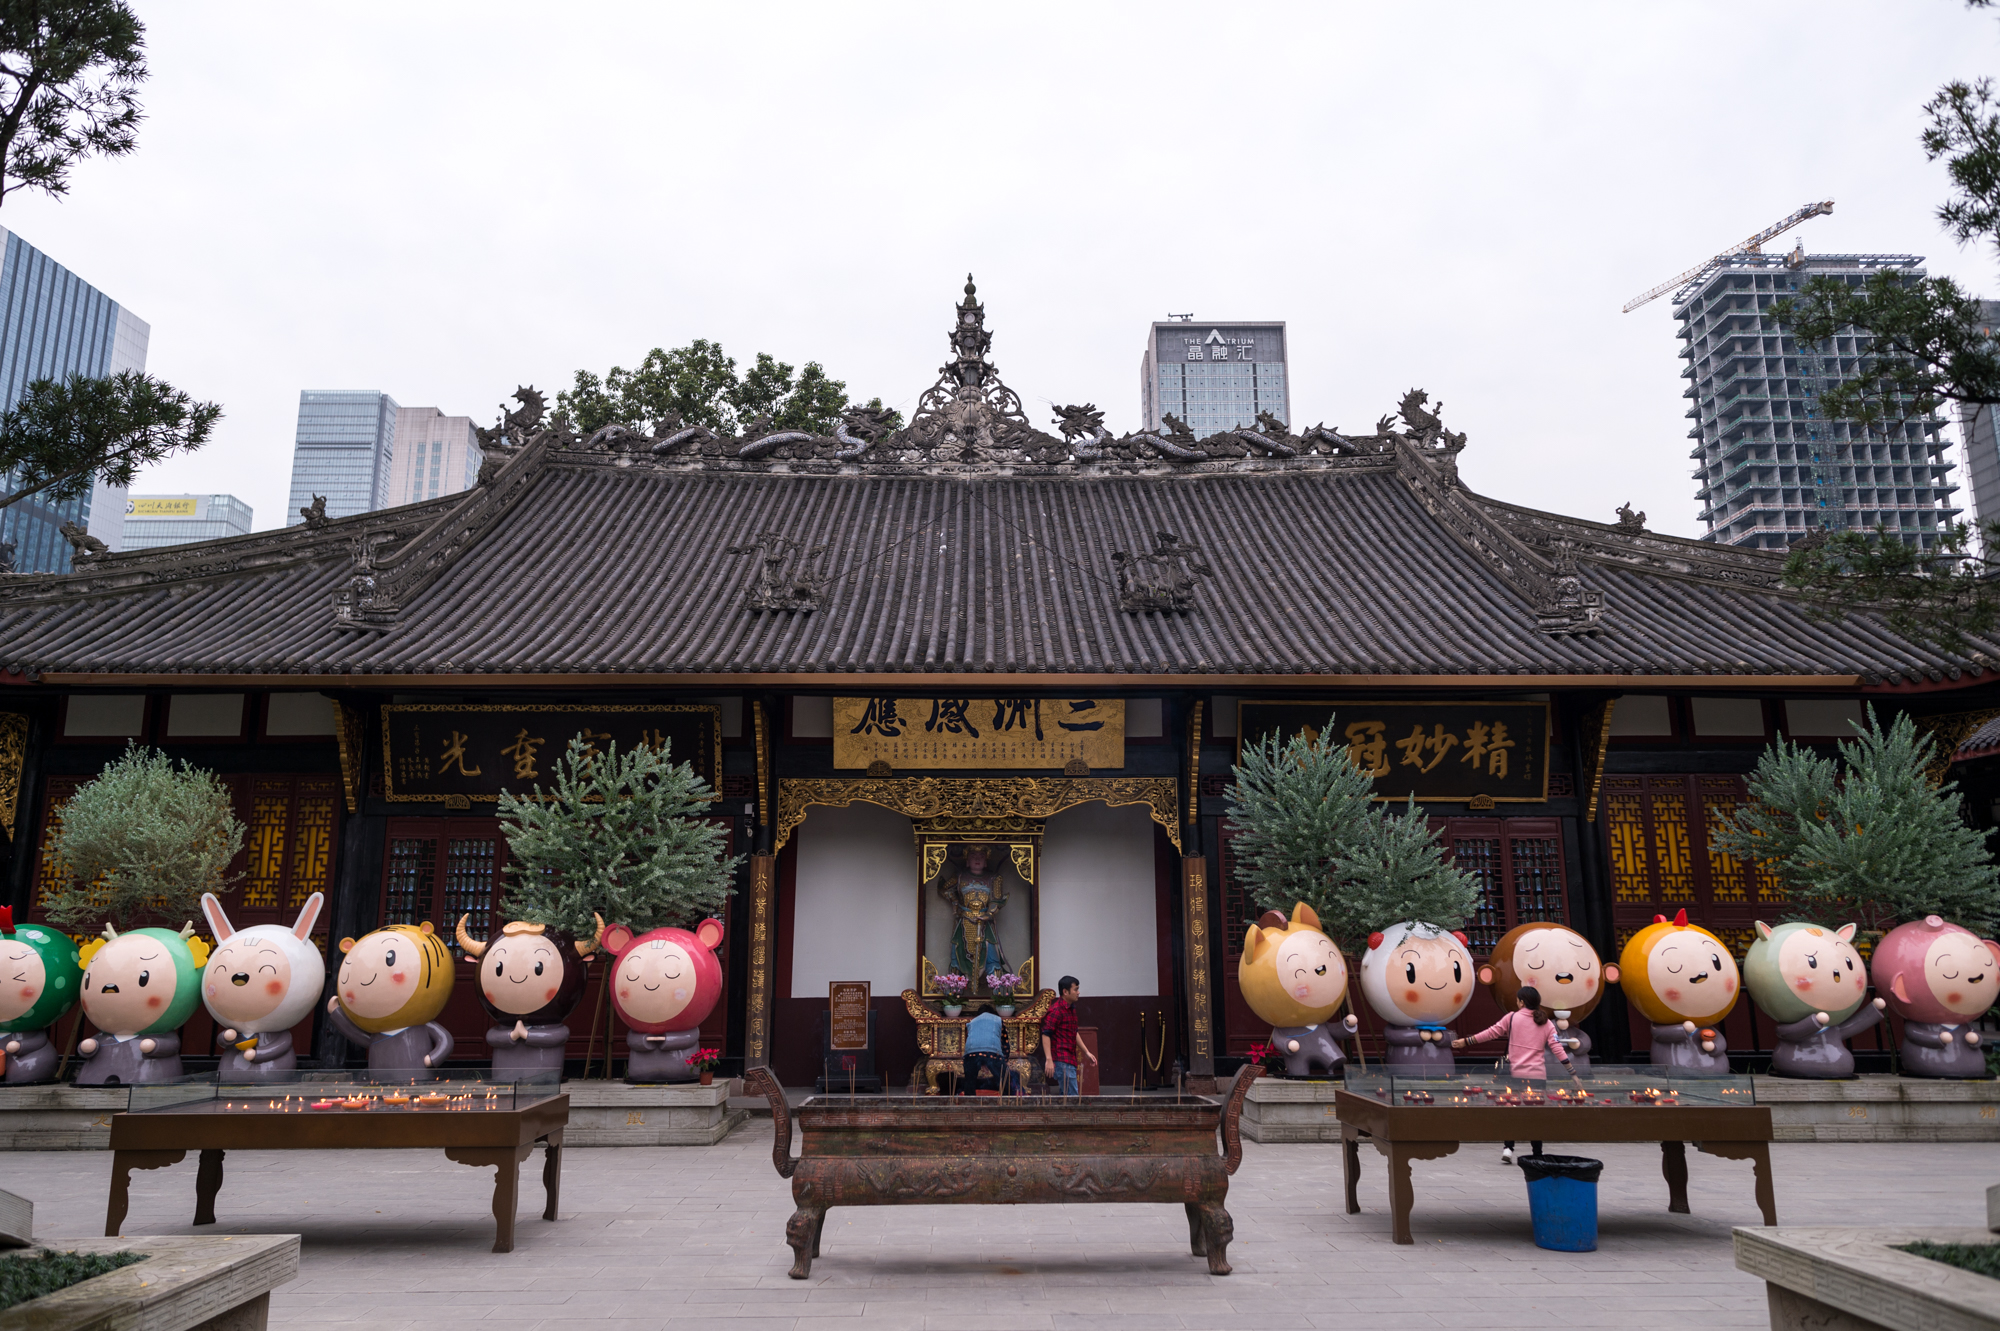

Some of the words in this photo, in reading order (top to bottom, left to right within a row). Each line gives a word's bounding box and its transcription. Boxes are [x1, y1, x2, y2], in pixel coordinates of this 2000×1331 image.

[1187, 346, 1253, 360] 晶融汇
[626, 1111, 645, 1126] 鼠
[1847, 1105, 1868, 1119] 狗
[1978, 1105, 1997, 1119] 猪
[91, 1113, 112, 1128] 龙
